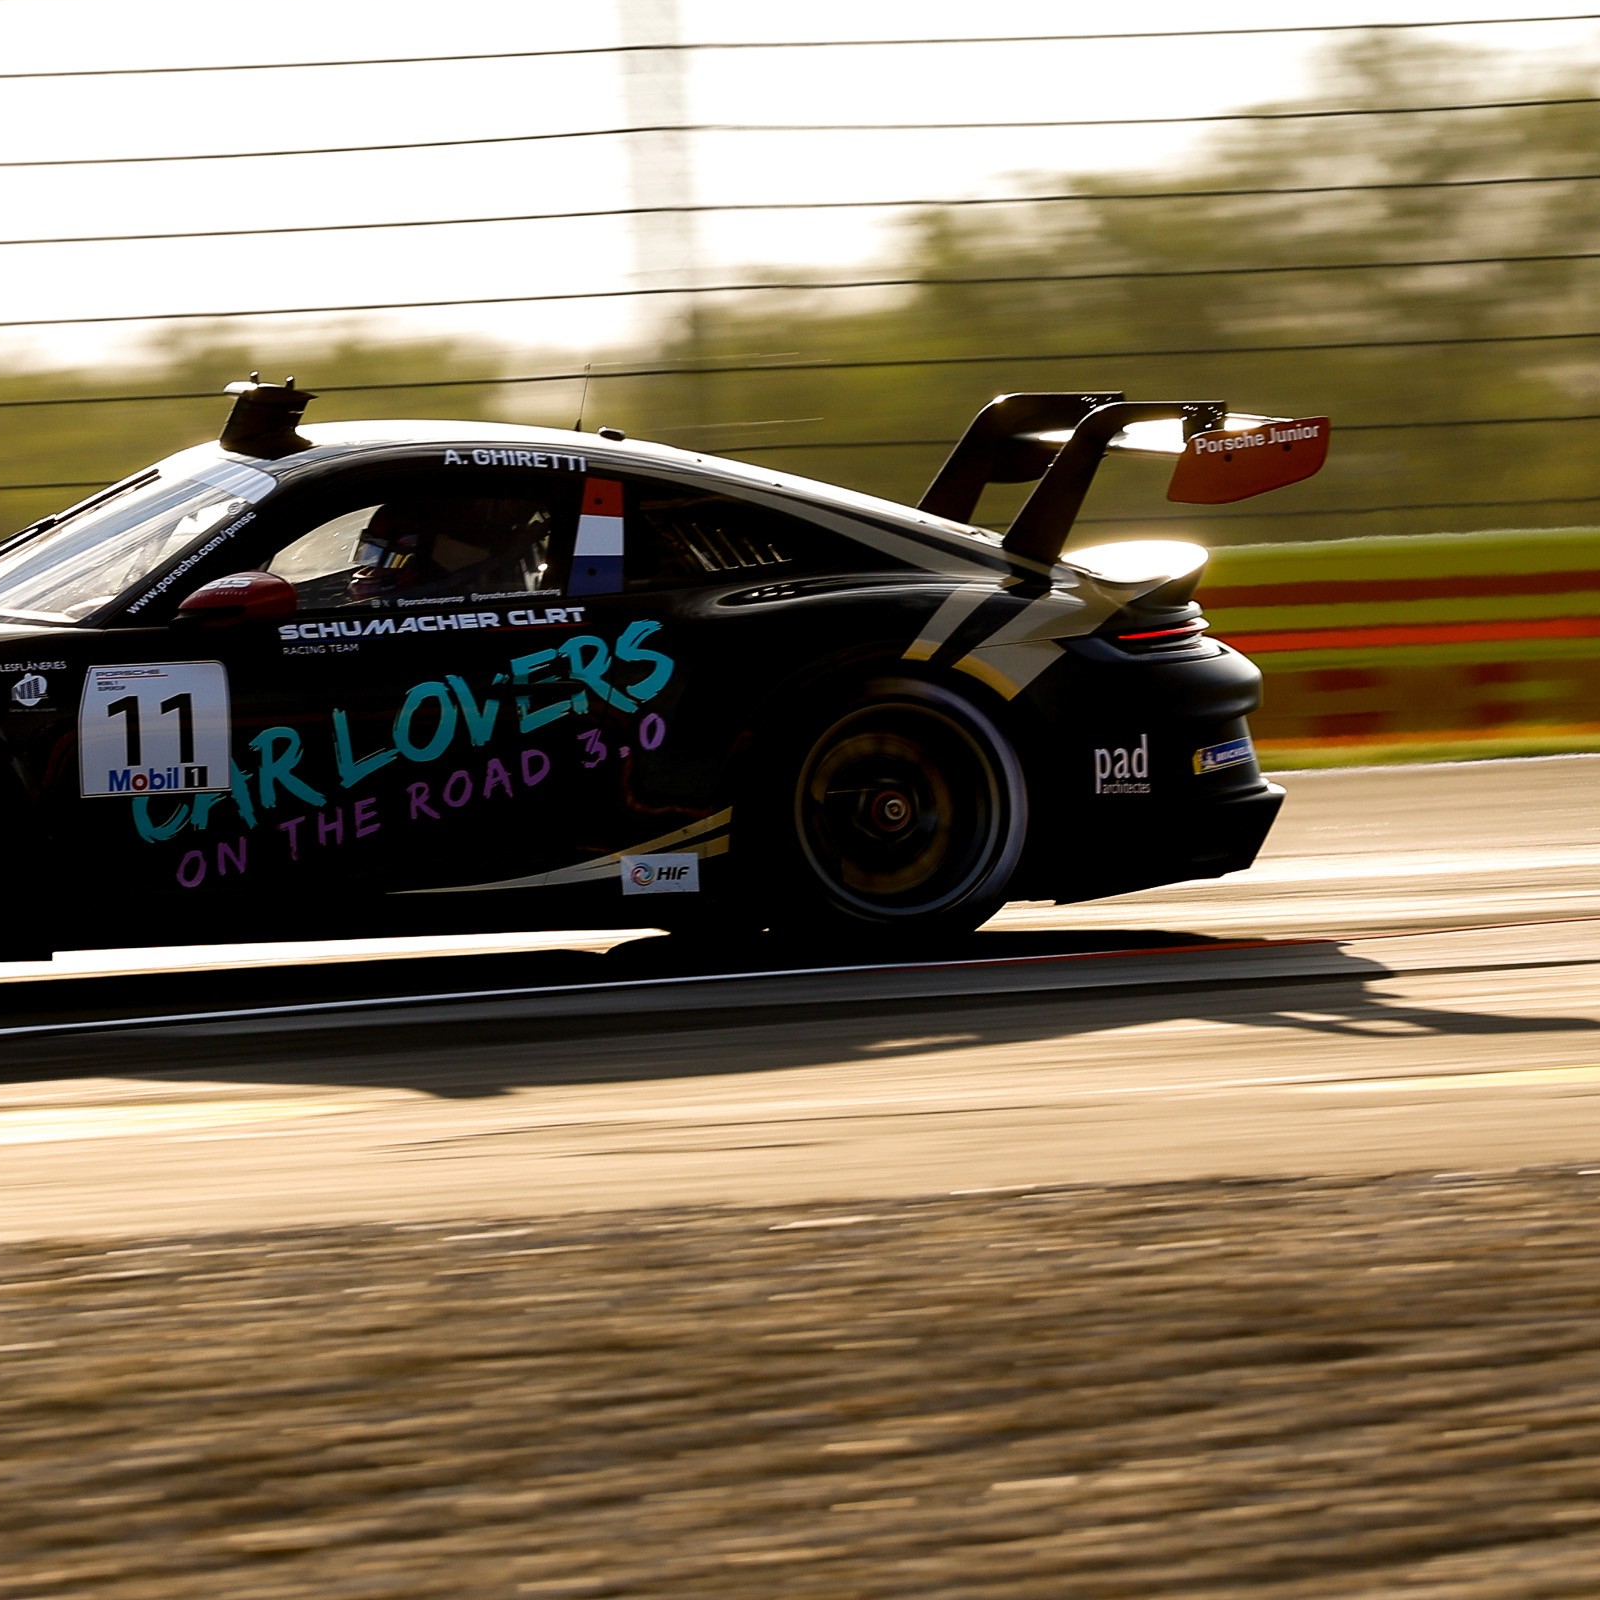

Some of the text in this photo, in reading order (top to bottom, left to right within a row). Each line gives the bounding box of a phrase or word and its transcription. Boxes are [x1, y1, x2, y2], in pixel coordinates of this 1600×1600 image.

[1194, 424, 1320, 455] Porsche Junior
[443, 449, 587, 473] A. GHIRETTI
[126, 511, 257, 614] www.porsche.com/pmsc
[278, 606, 586, 641] SCHUMACHER CLRT
[283, 643, 360, 656] RACING TEAM
[96, 669, 160, 678] PORSCHE
[107, 692, 195, 767] 11
[1094, 733, 1148, 794] pad
[108, 766, 179, 793] Mobil
[1102, 780, 1151, 794] architectes
[176, 713, 667, 888] ON THE ROAD 3.0
[657, 866, 690, 881] HIF
